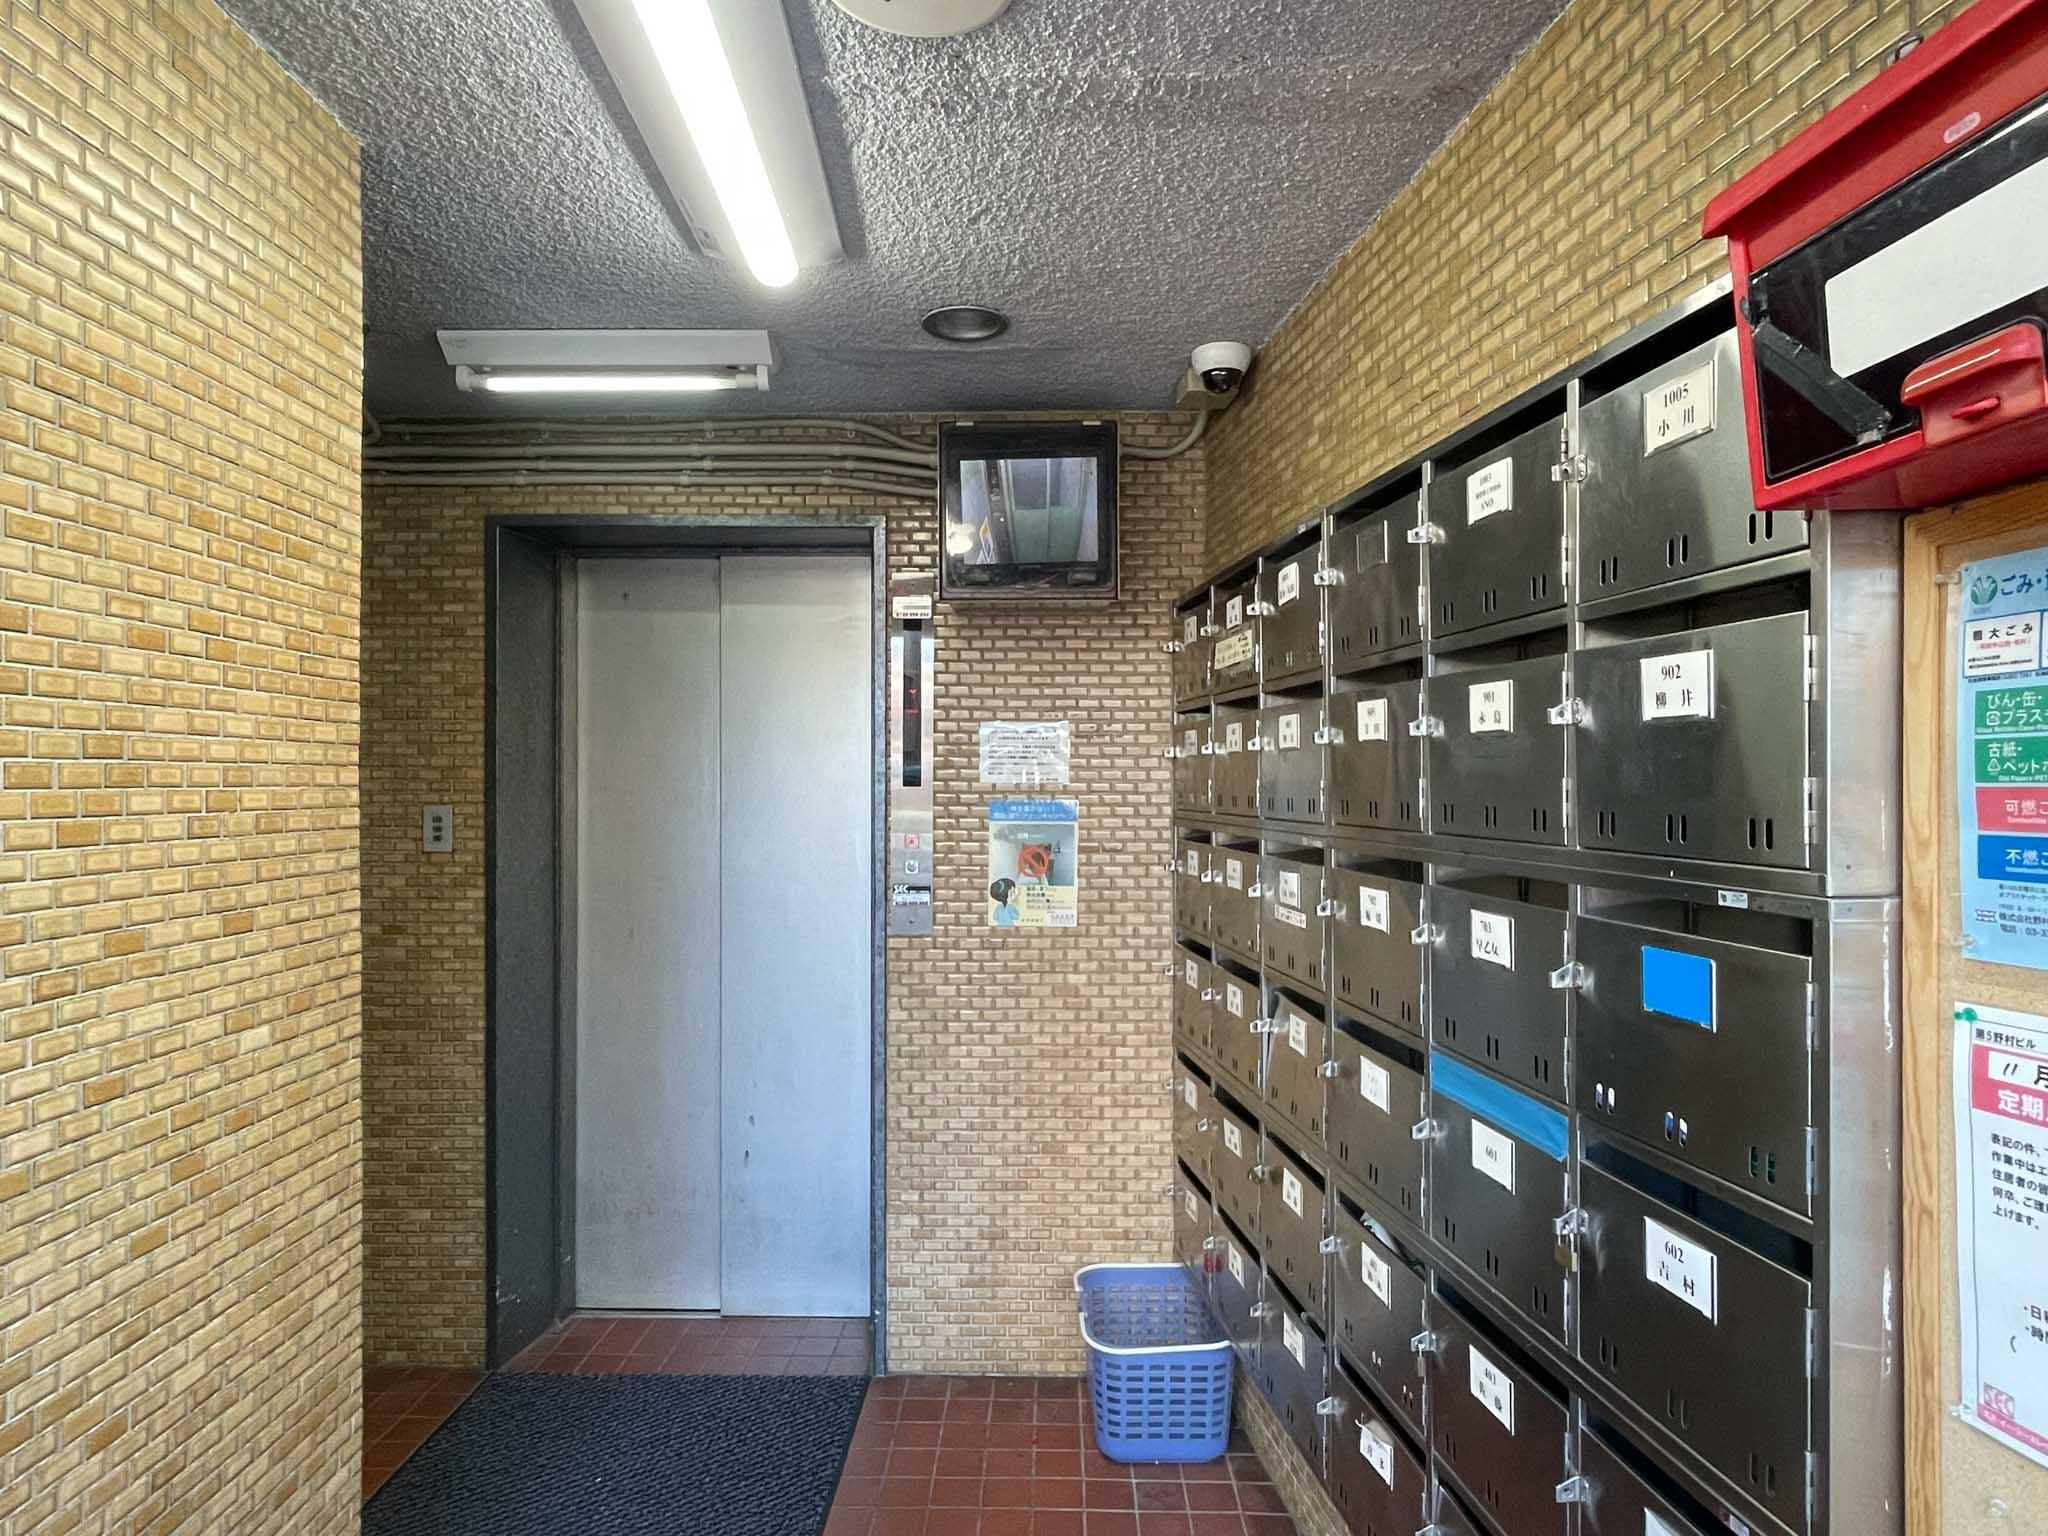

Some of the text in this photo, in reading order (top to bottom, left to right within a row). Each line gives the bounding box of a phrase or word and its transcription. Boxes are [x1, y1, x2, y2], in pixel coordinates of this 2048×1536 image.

[1664, 382, 1689, 408] 1005
[2000, 570, 2048, 596] ごみ・
[1661, 663, 1682, 681] 902
[2002, 708, 2048, 725] プラス
[1975, 1028, 2036, 1049] 第5野村ビル
[1998, 1089, 2048, 1122] 定期
[1991, 1133, 2048, 1157] 表記の件、
[1992, 1186, 2048, 1215] 何卒、ご理
[1664, 1240, 1685, 1264] 602
